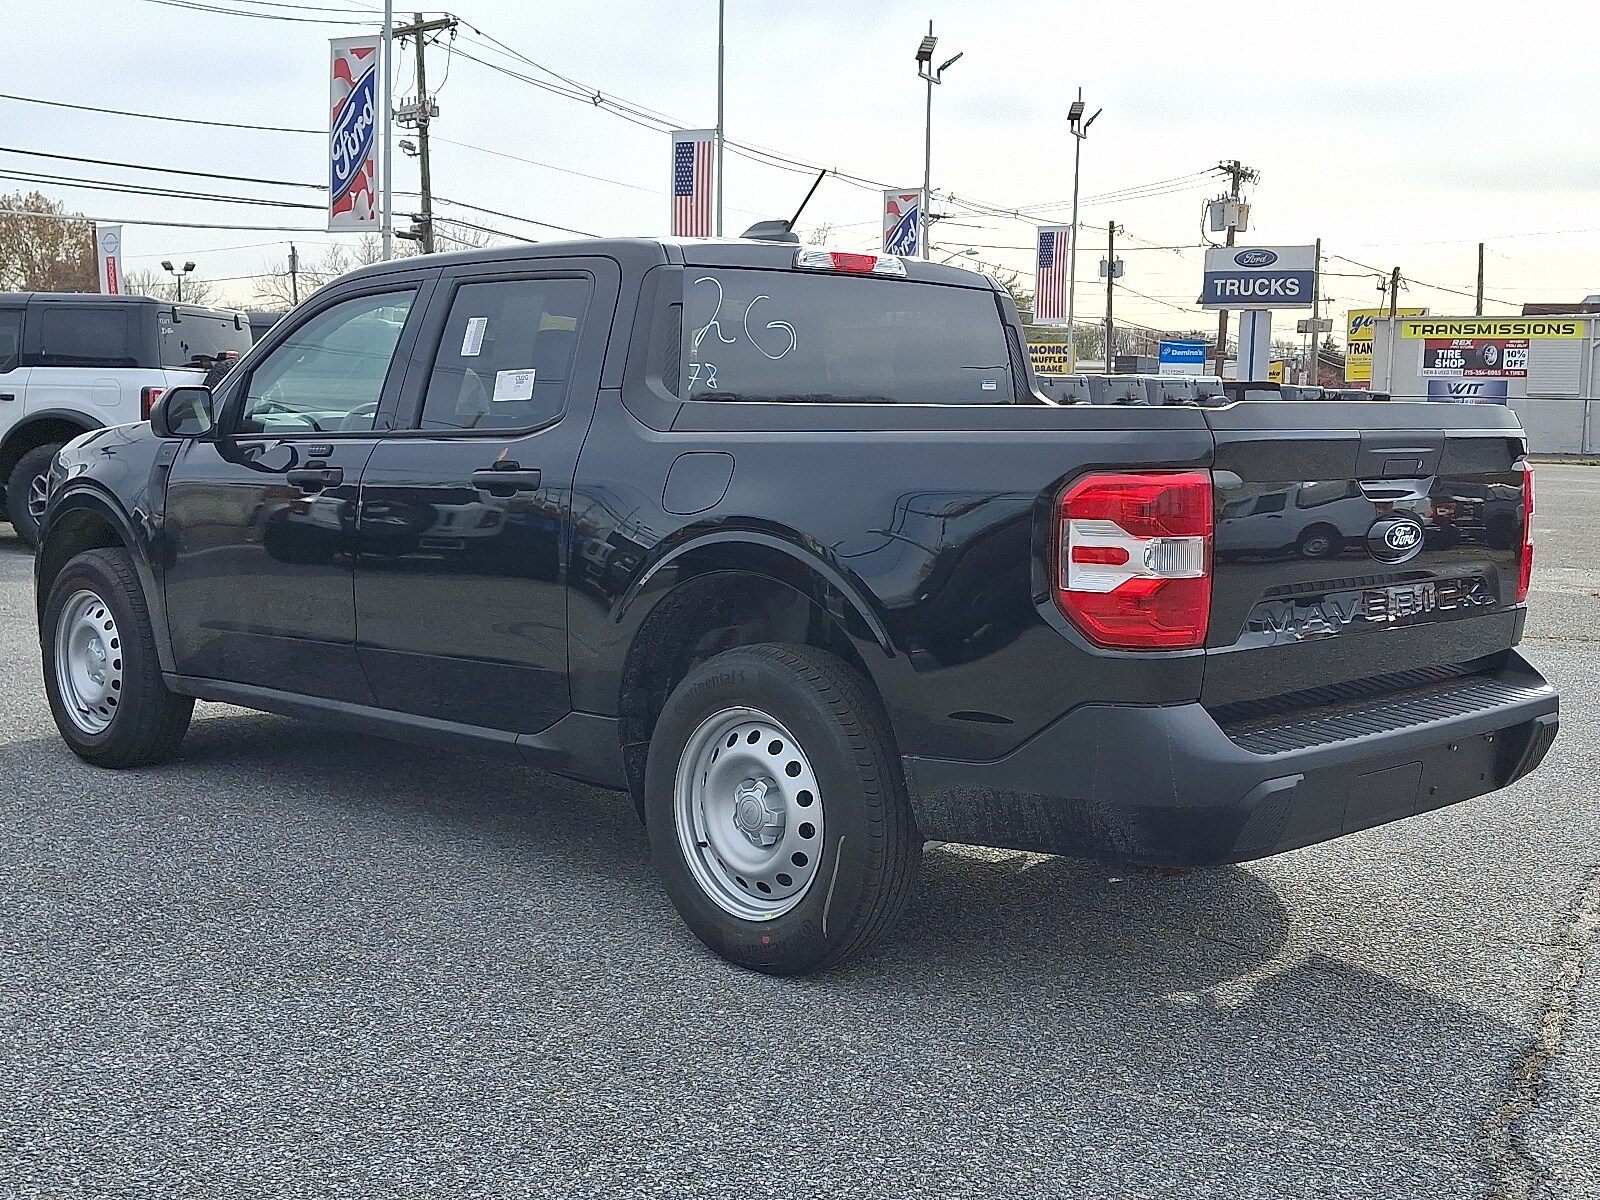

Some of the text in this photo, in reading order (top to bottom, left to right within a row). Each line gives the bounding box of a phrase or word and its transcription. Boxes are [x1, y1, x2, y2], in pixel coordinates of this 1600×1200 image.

[332, 86, 374, 180] Ford
[1243, 252, 1267, 264] Ford
[1213, 278, 1300, 296] TRUCKS
[1409, 323, 1575, 335] TRANSMISSIONS
[1437, 350, 1462, 359] TIRE
[1506, 350, 1526, 358] 10%
[1035, 365, 1063, 373] BRAKE
[1434, 359, 1465, 368] SHOP
[1506, 360, 1525, 368] OFF
[687, 362, 718, 391] 78
[1447, 383, 1484, 395] WIT
[1392, 526, 1416, 546] Ford
[1262, 581, 1498, 634] MAVERICK
